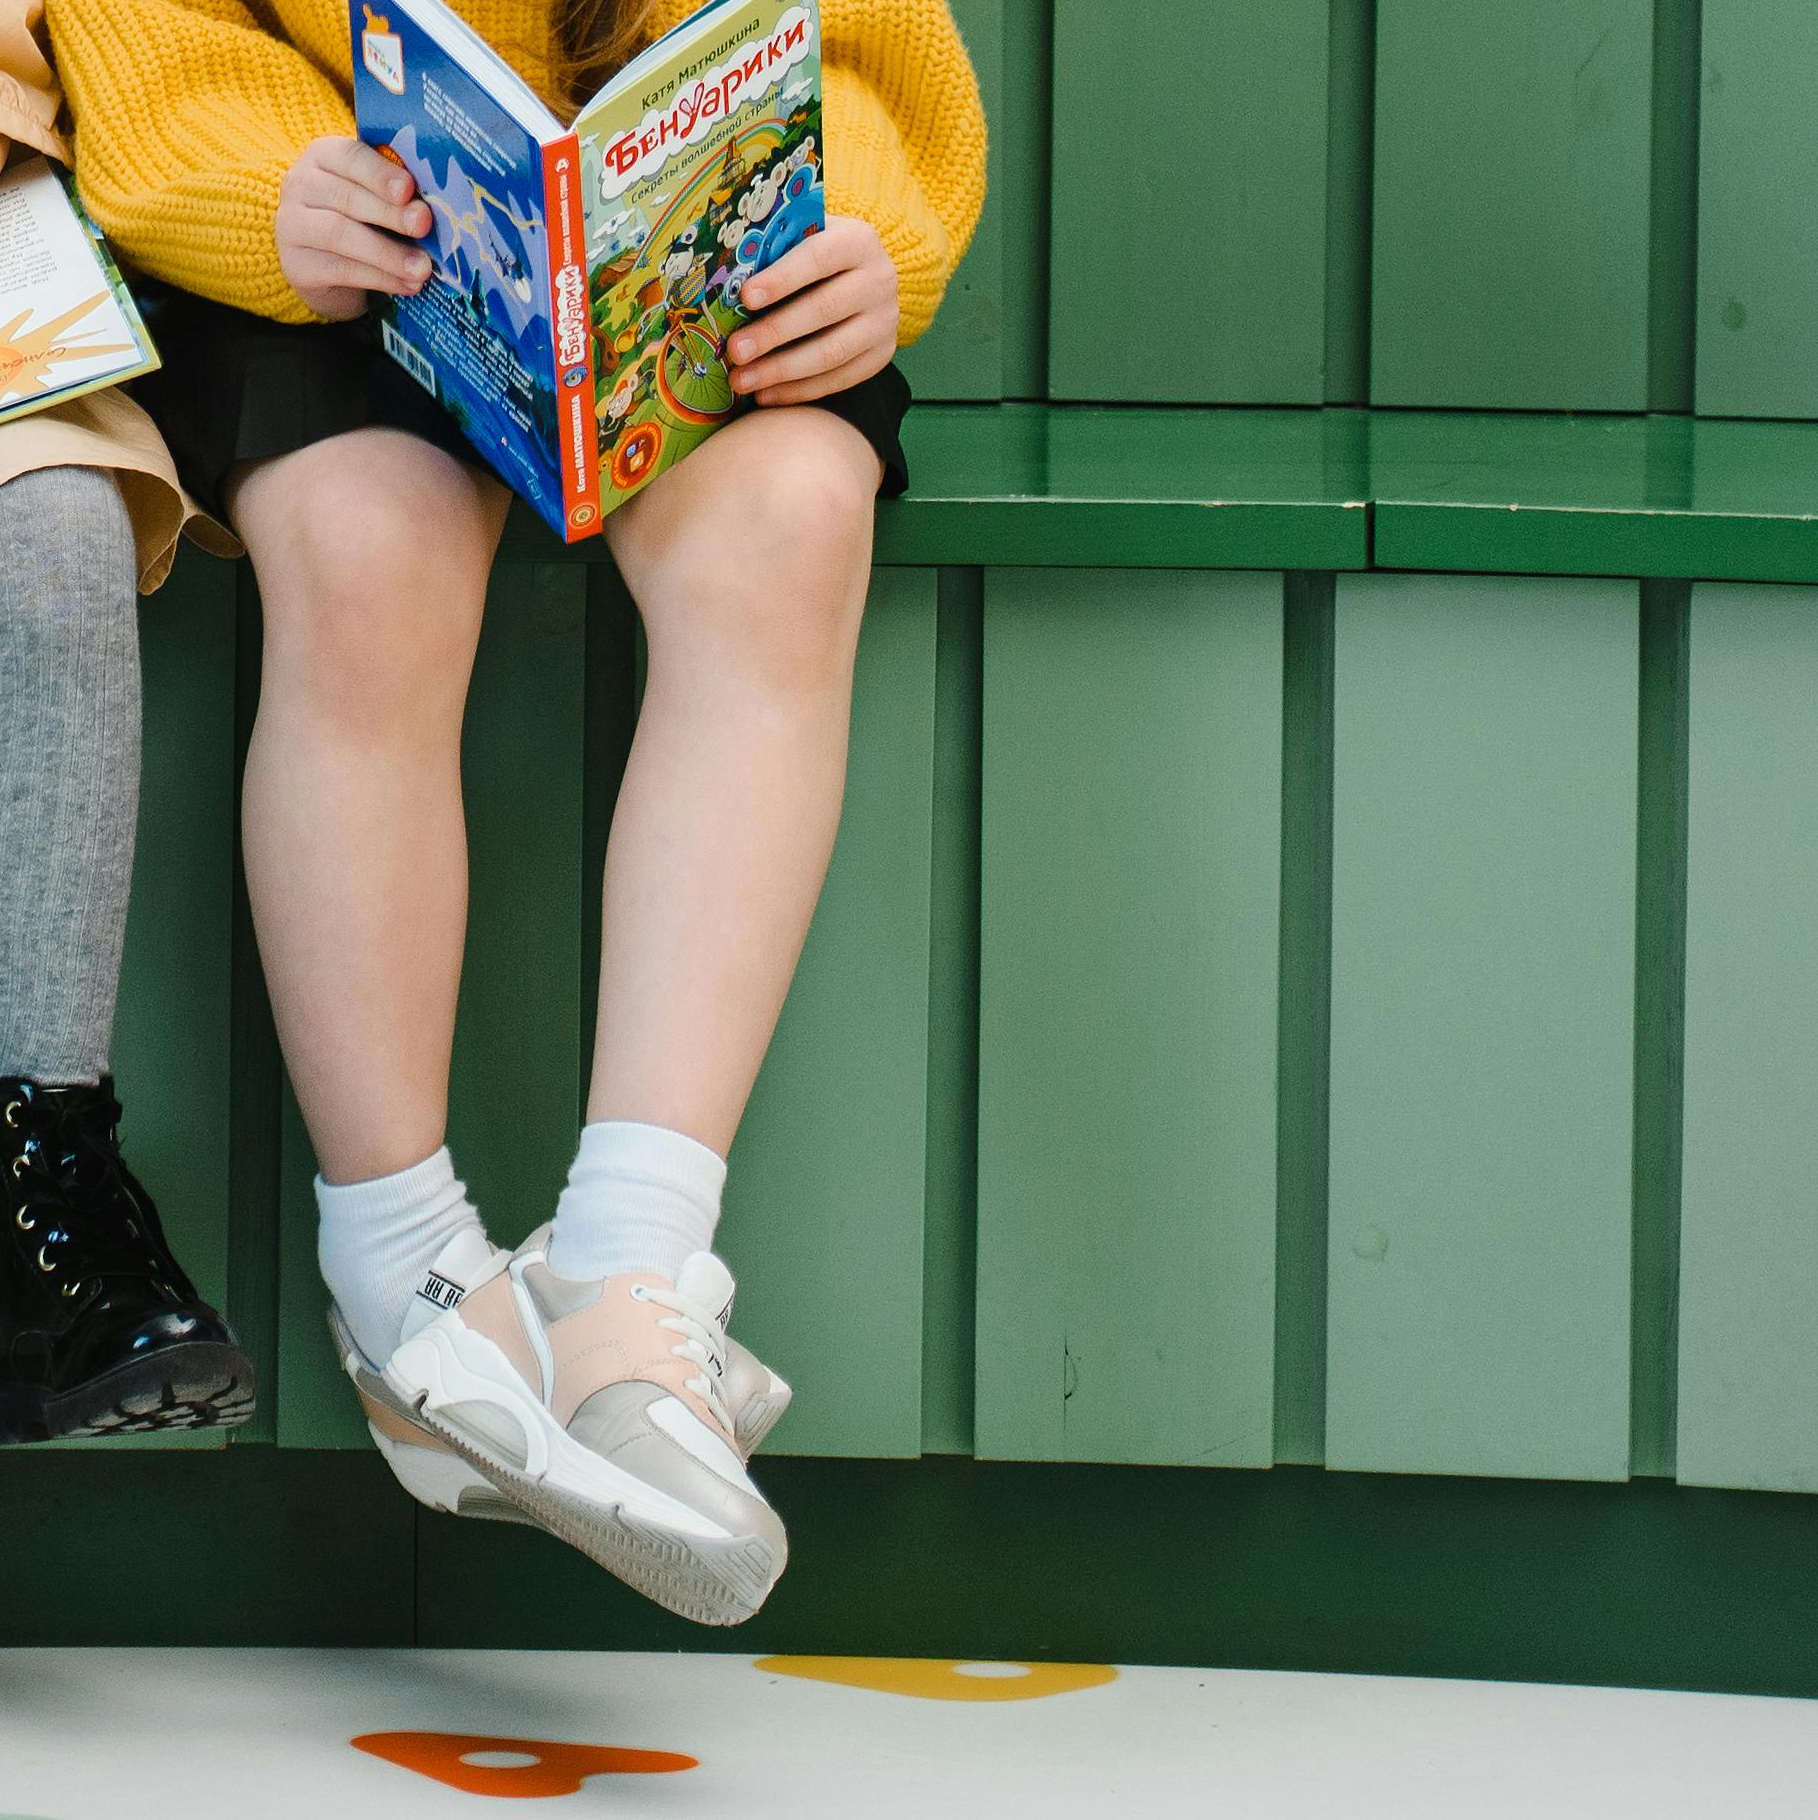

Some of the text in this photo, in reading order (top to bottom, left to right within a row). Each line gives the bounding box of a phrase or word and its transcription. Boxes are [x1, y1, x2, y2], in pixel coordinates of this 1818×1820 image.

[641, 18, 761, 111] Катя Матюшкина
[680, 116, 742, 169] волшебной
[744, 88, 783, 122] страны
